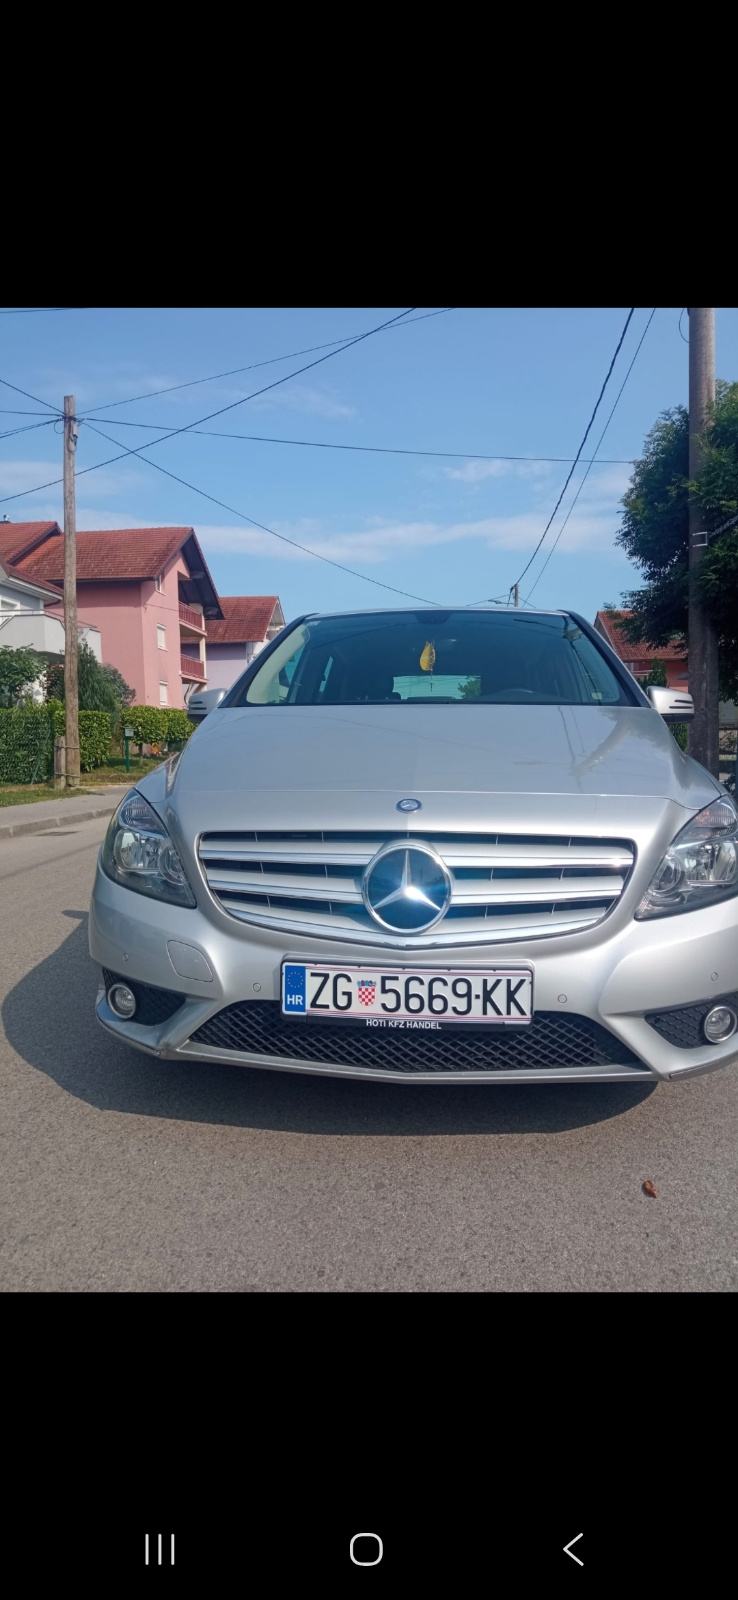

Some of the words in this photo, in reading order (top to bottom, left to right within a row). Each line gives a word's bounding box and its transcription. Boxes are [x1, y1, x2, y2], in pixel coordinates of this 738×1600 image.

[310, 972, 353, 1010] ZG
[287, 994, 303, 1006] HR
[366, 1019, 386, 1027] HOTI
[388, 1020, 405, 1028] KFZ
[406, 1021, 442, 1030] HANDEL
